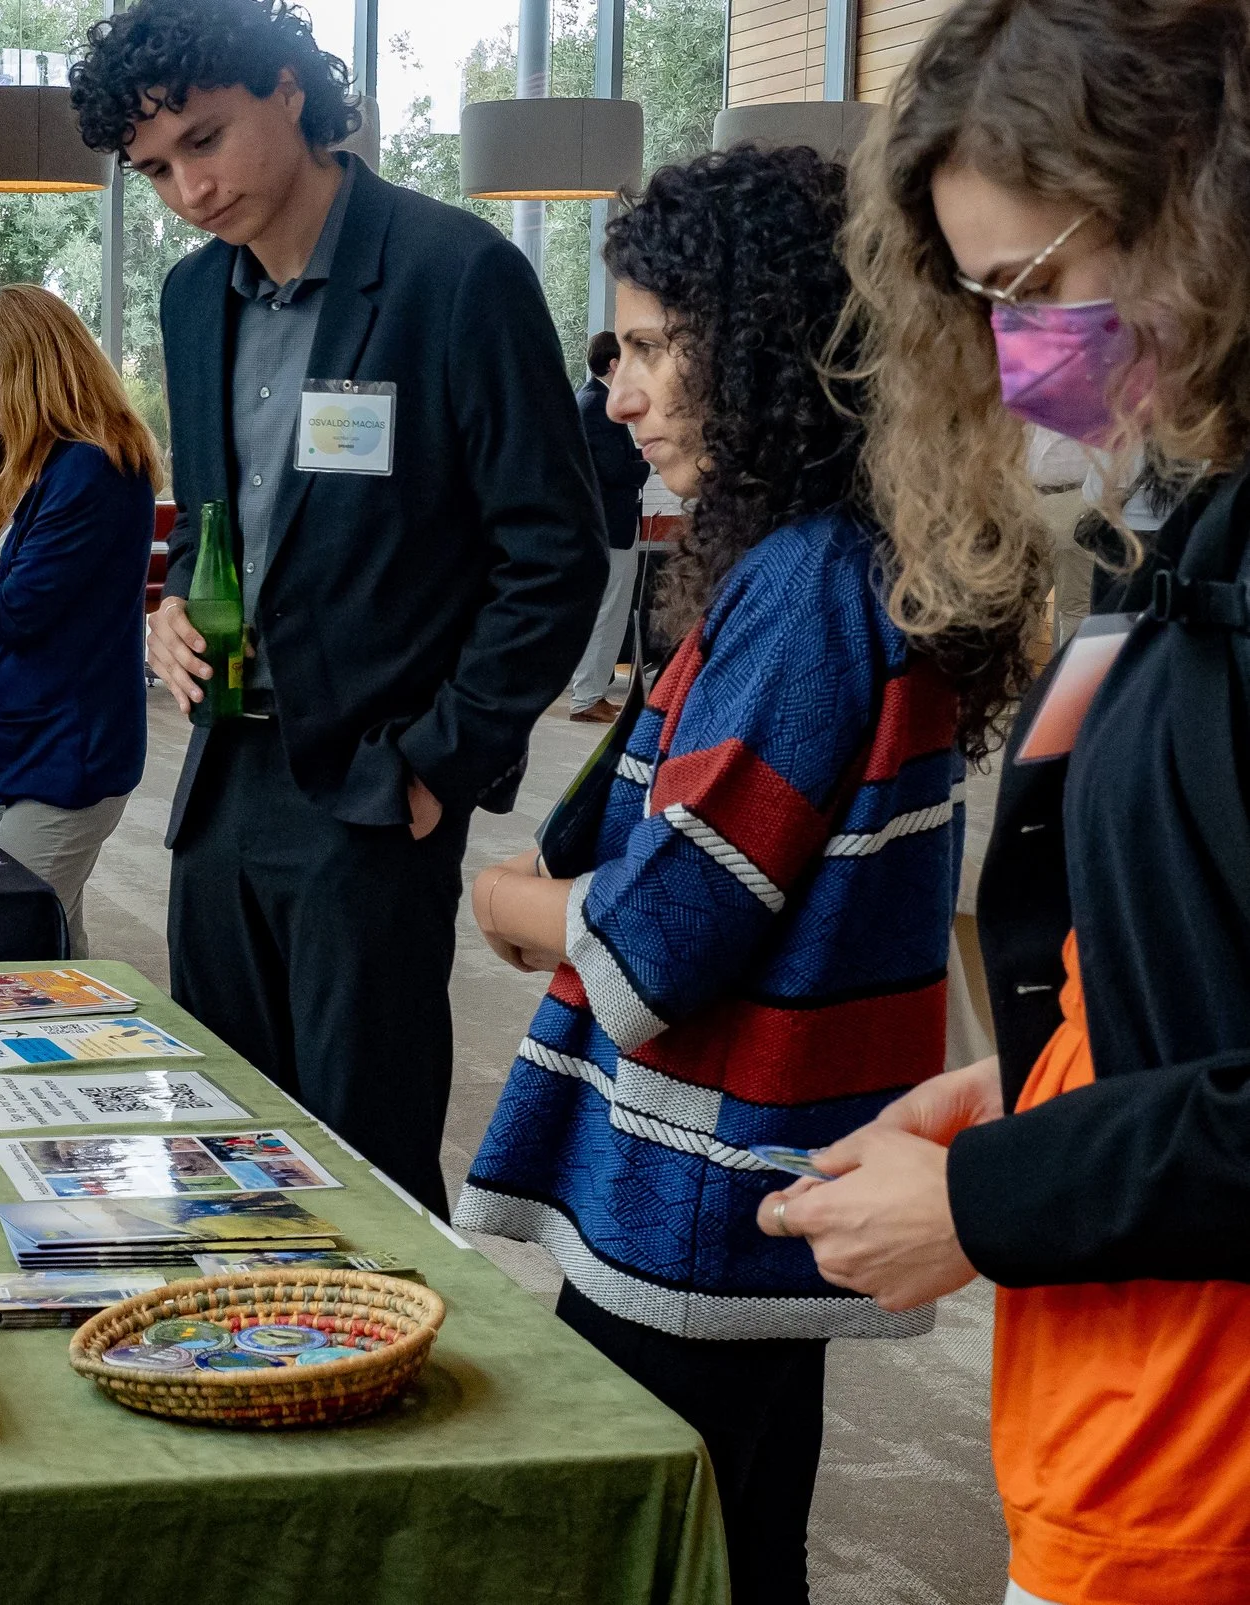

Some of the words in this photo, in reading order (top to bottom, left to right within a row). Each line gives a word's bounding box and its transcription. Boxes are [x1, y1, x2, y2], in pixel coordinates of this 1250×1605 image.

[309, 418, 350, 428] OSVALDO
[352, 420, 385, 429] MACIAS
[1, 1077, 18, 1090] about
[26, 1106, 49, 1125] newsletter
